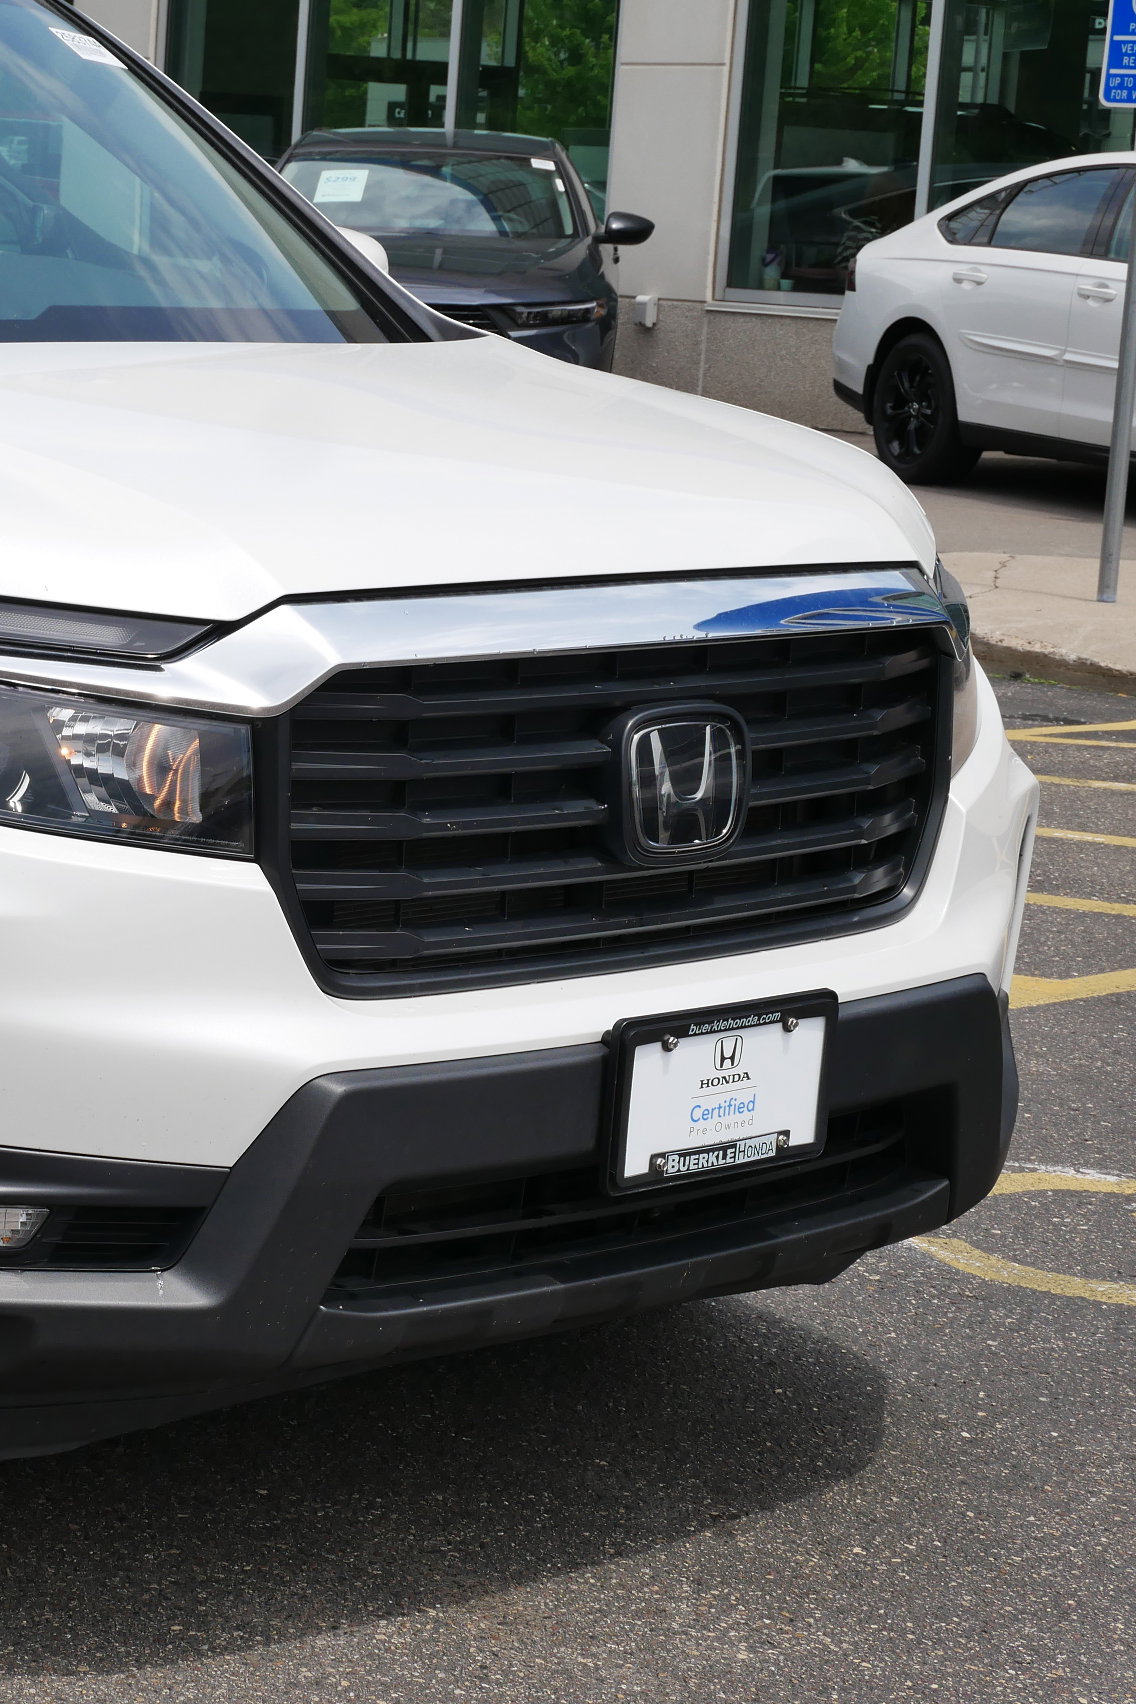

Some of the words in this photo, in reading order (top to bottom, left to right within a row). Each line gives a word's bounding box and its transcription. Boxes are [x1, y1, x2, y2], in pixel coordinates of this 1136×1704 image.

[1109, 77, 1121, 87] UP
[1124, 77, 1134, 87] TO
[1111, 89, 1128, 100] FOR
[688, 1011, 781, 1036] buerklehonda.com
[698, 1071, 752, 1090] HONDA
[690, 1094, 756, 1123] Certified
[688, 1115, 754, 1138] Pre-Owned
